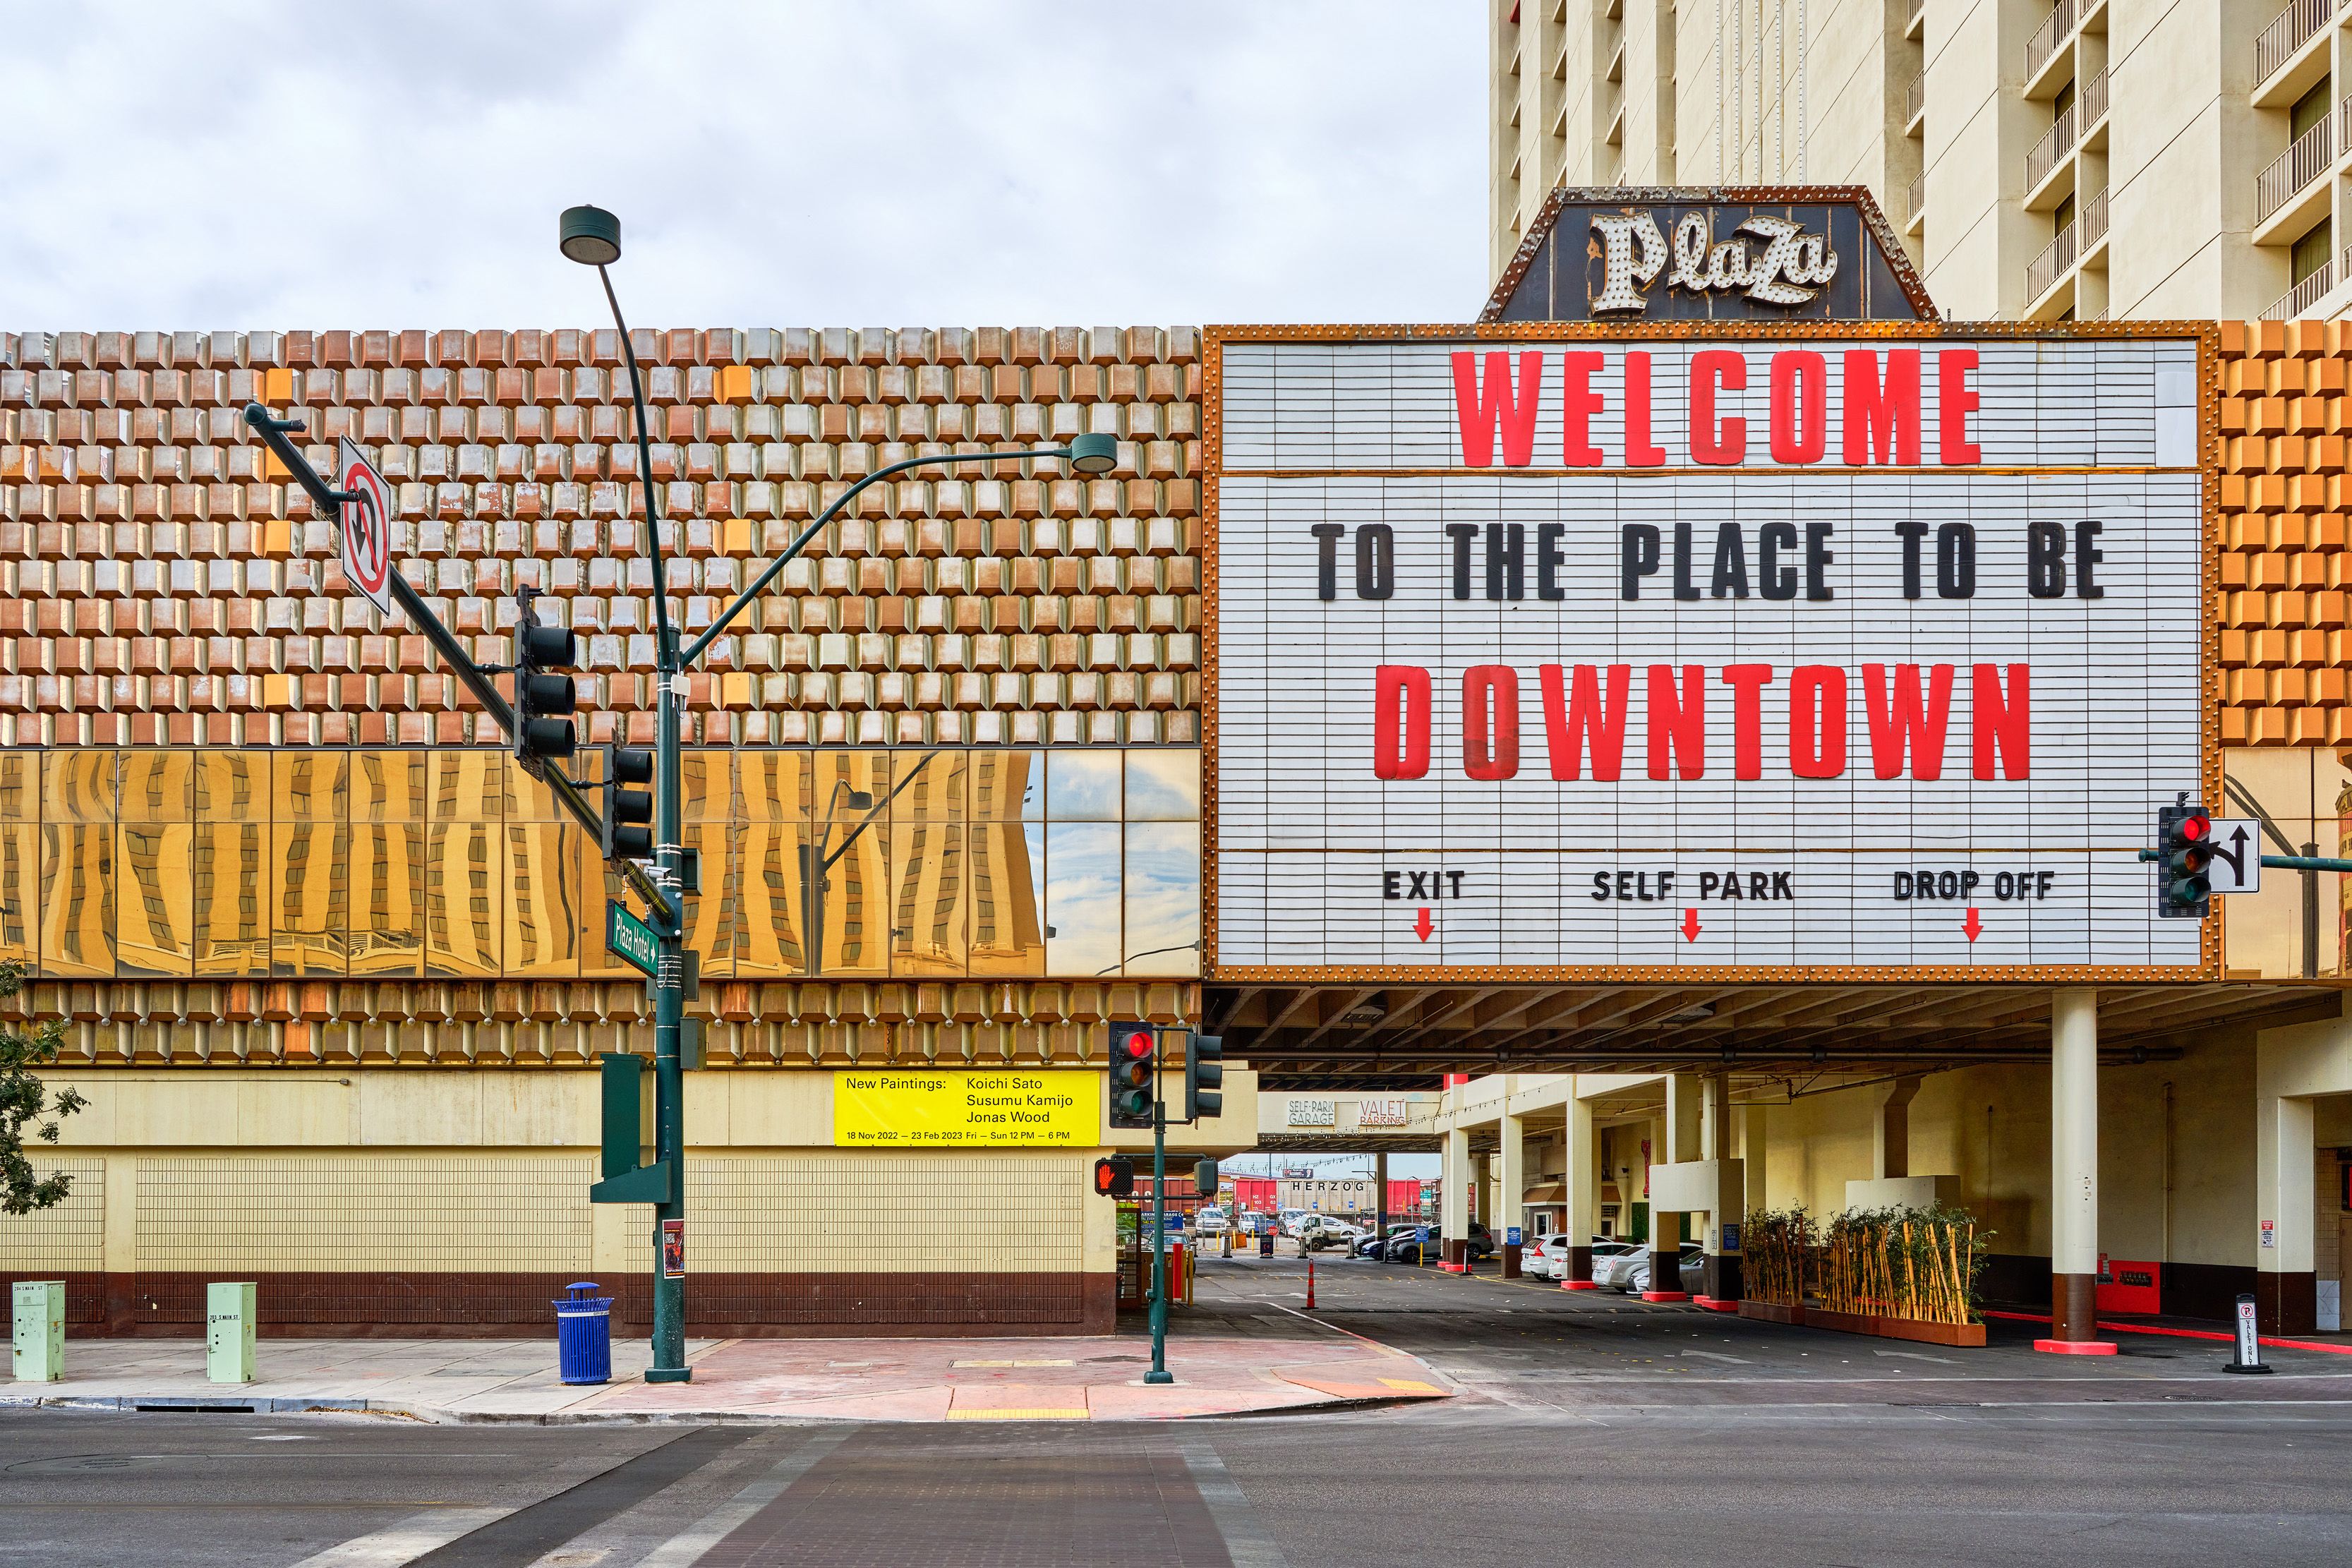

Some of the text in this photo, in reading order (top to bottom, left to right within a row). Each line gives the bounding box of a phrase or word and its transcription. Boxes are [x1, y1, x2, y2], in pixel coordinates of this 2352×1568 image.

[1451, 349, 1981, 467] WELCOME
[1311, 521, 2104, 601] TO THE PLACE TO BE
[1375, 663, 2030, 781] DOWNTOWN
[1383, 870, 1464, 900] EXIT
[1591, 870, 1794, 900] SELF PARK
[1894, 870, 2055, 900] DROP OFF
[615, 912, 650, 963] Plaza Hotel
[847, 1078, 947, 1092] New Paintings:
[967, 1078, 1042, 1089] Koichi Sato
[967, 1094, 1073, 1108] Susumu Kamijo
[1360, 1100, 1405, 1116] VALET
[966, 1111, 1049, 1123] Jonas Wood
[1289, 1113, 1334, 1125] GARAGE
[1360, 1116, 1406, 1125] PARKING
[1292, 1182, 1364, 1191] HERZOG
